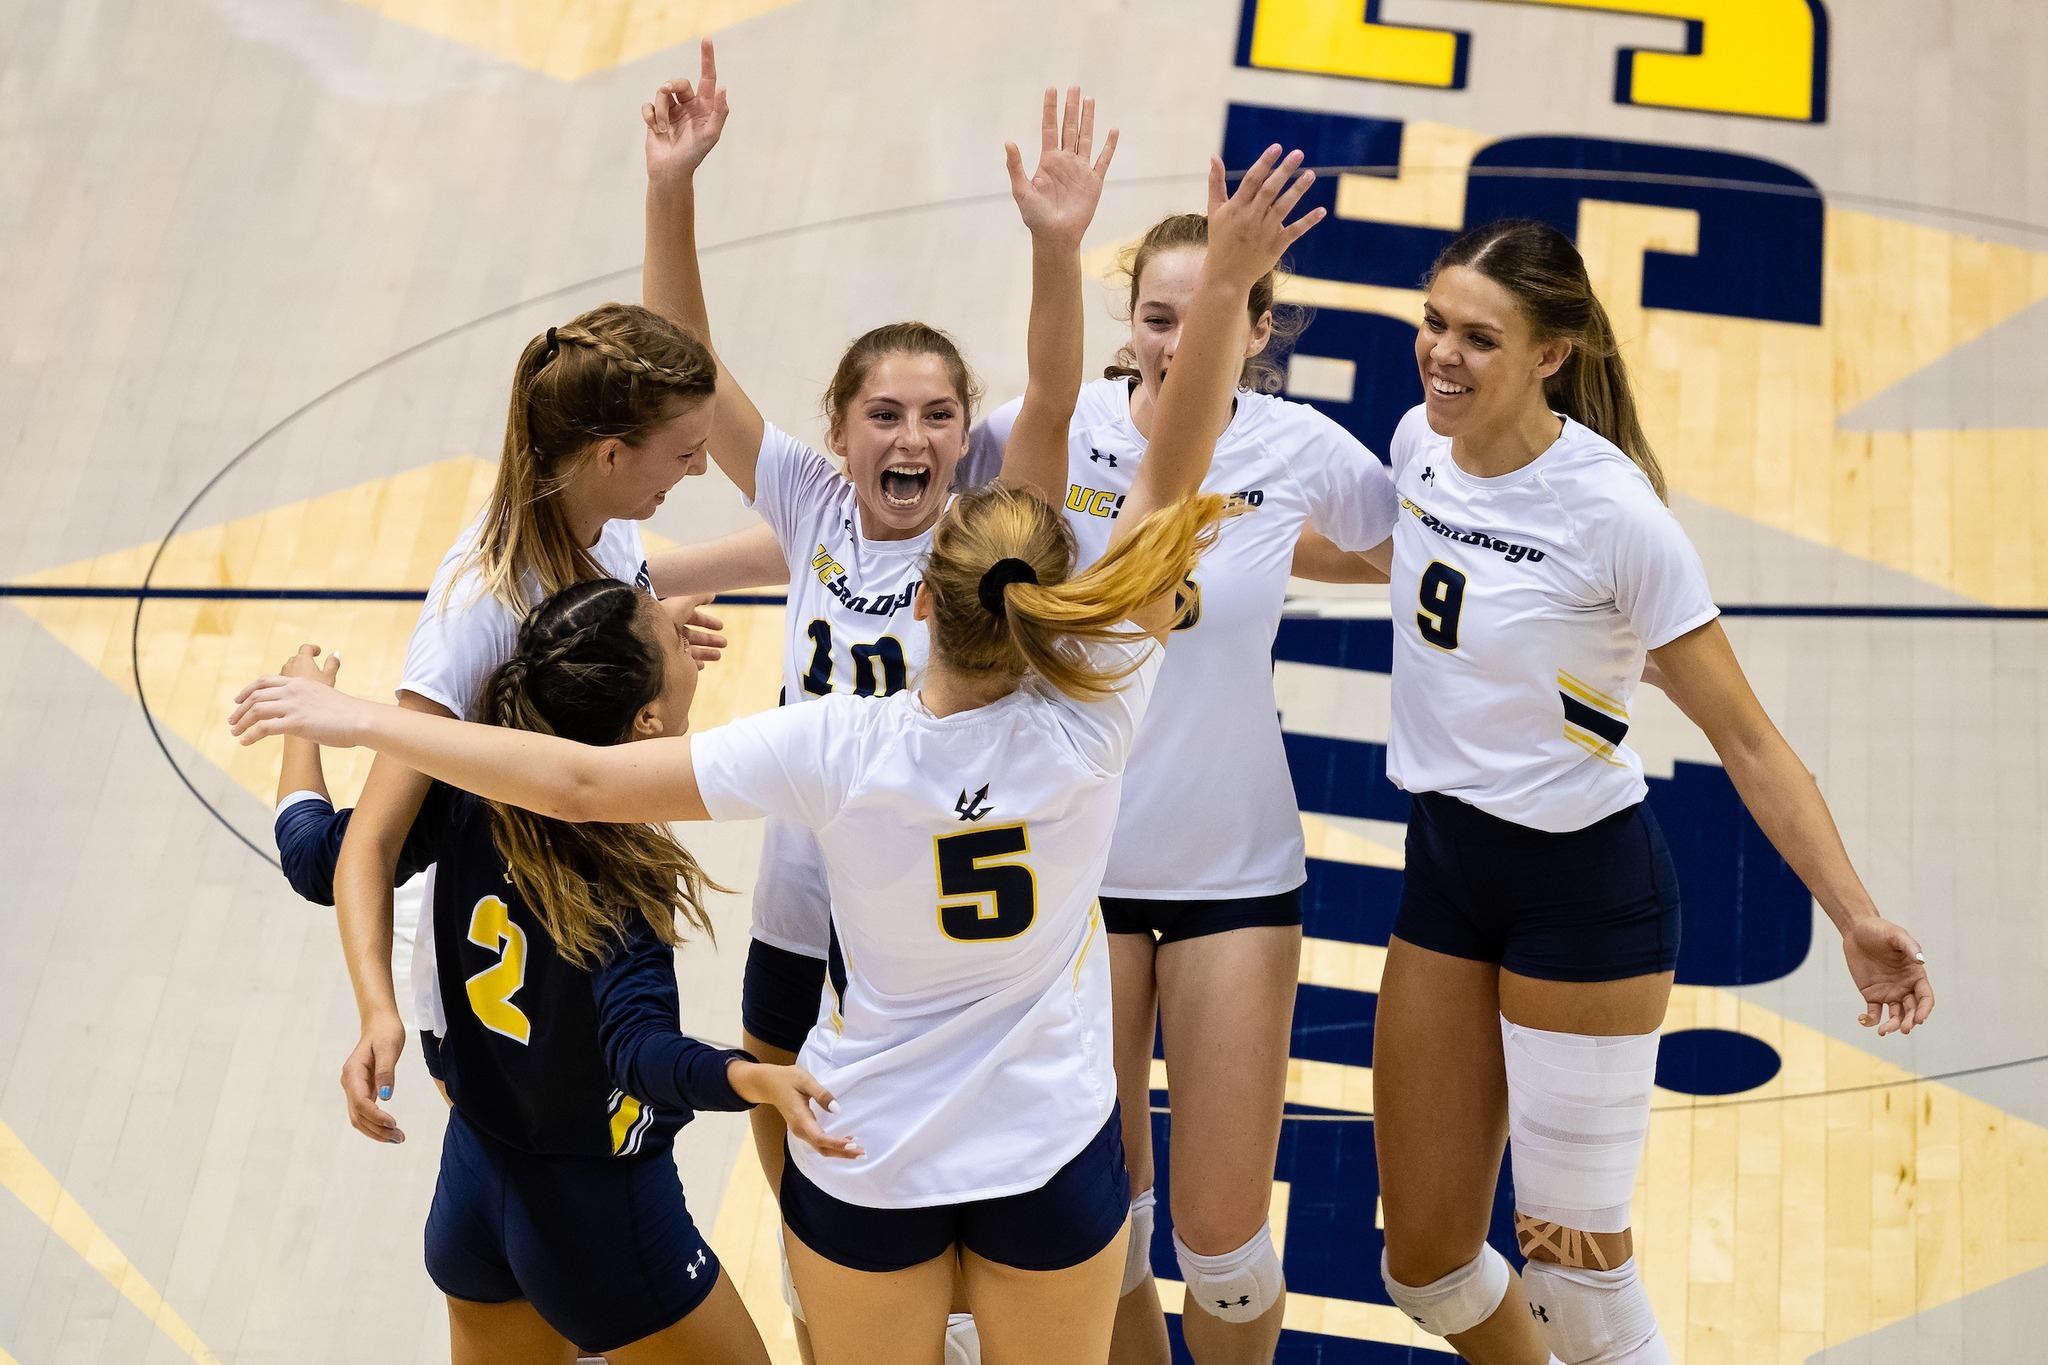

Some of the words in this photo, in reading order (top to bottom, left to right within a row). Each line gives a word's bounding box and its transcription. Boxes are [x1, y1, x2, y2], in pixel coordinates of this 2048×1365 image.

[802, 618, 908, 698] 10
[1416, 559, 1467, 653] 9
[933, 822, 1038, 943] 5
[465, 895, 531, 1046] 2
